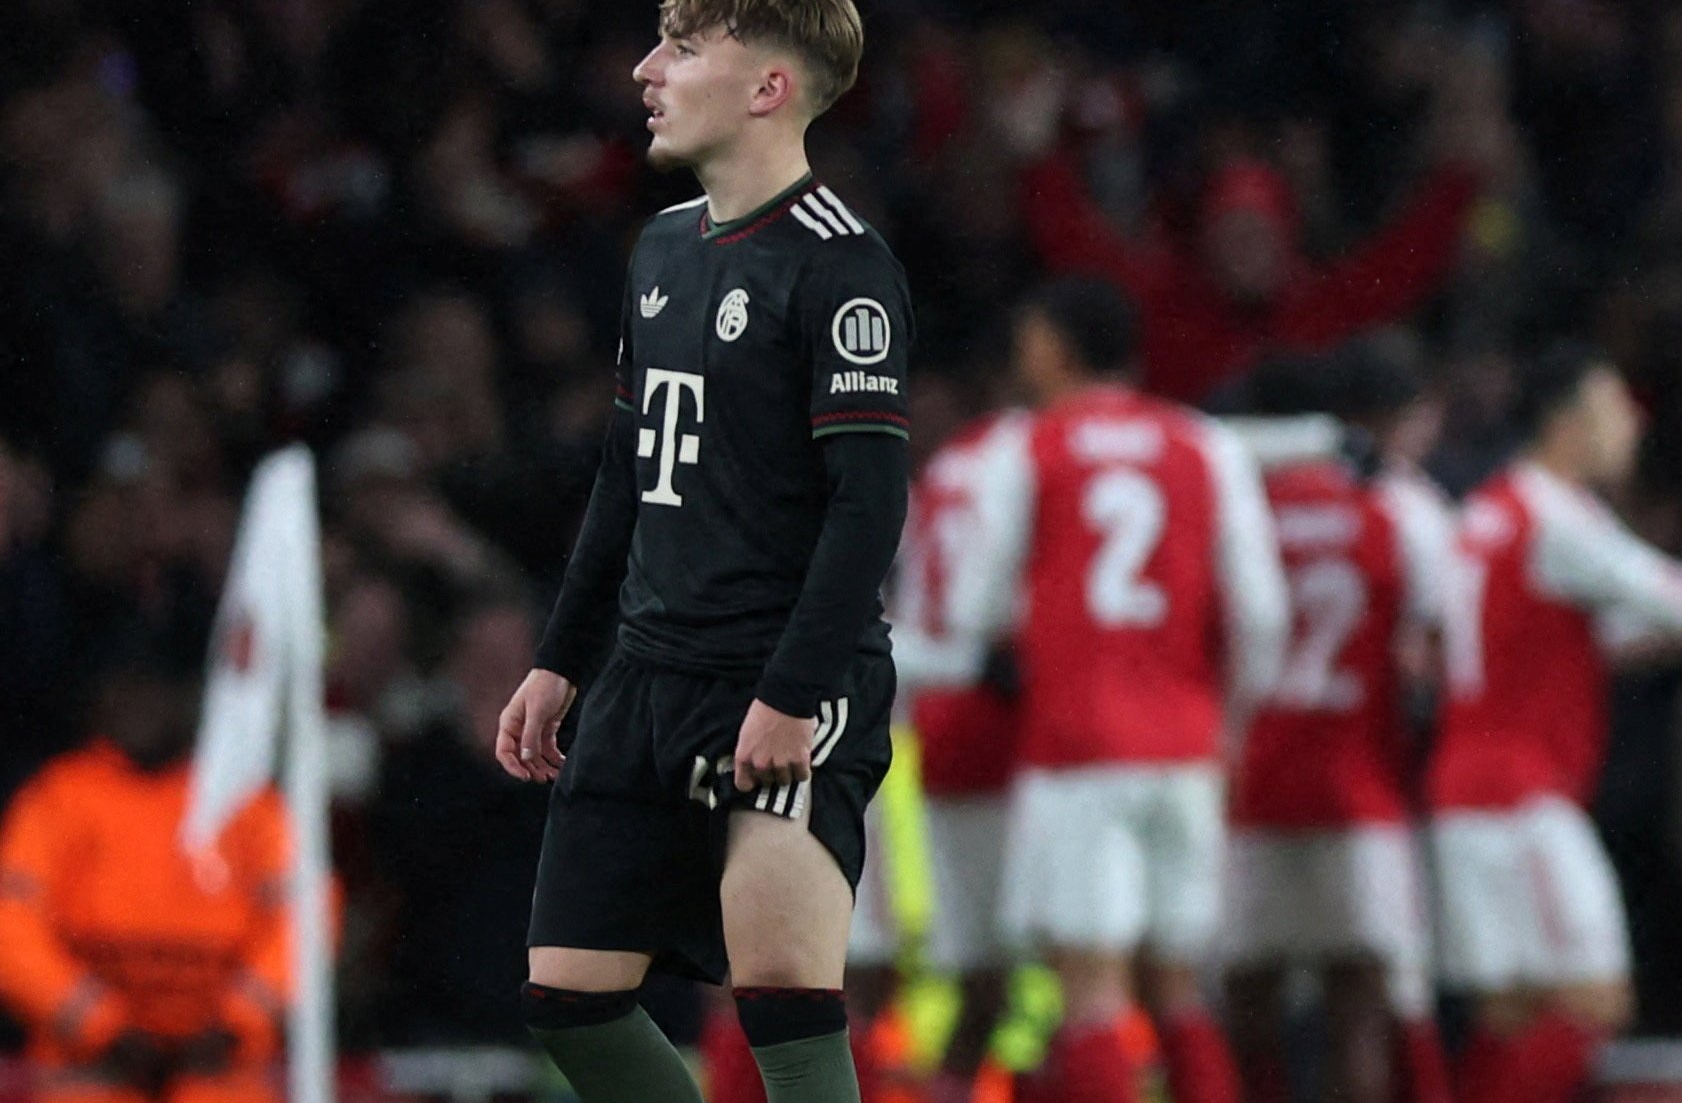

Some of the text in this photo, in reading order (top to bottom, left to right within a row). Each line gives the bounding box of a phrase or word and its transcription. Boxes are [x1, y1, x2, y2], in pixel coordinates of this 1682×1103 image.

[637, 368, 705, 507] T
[830, 372, 899, 395] Allianz
[1080, 465, 1171, 631] 2
